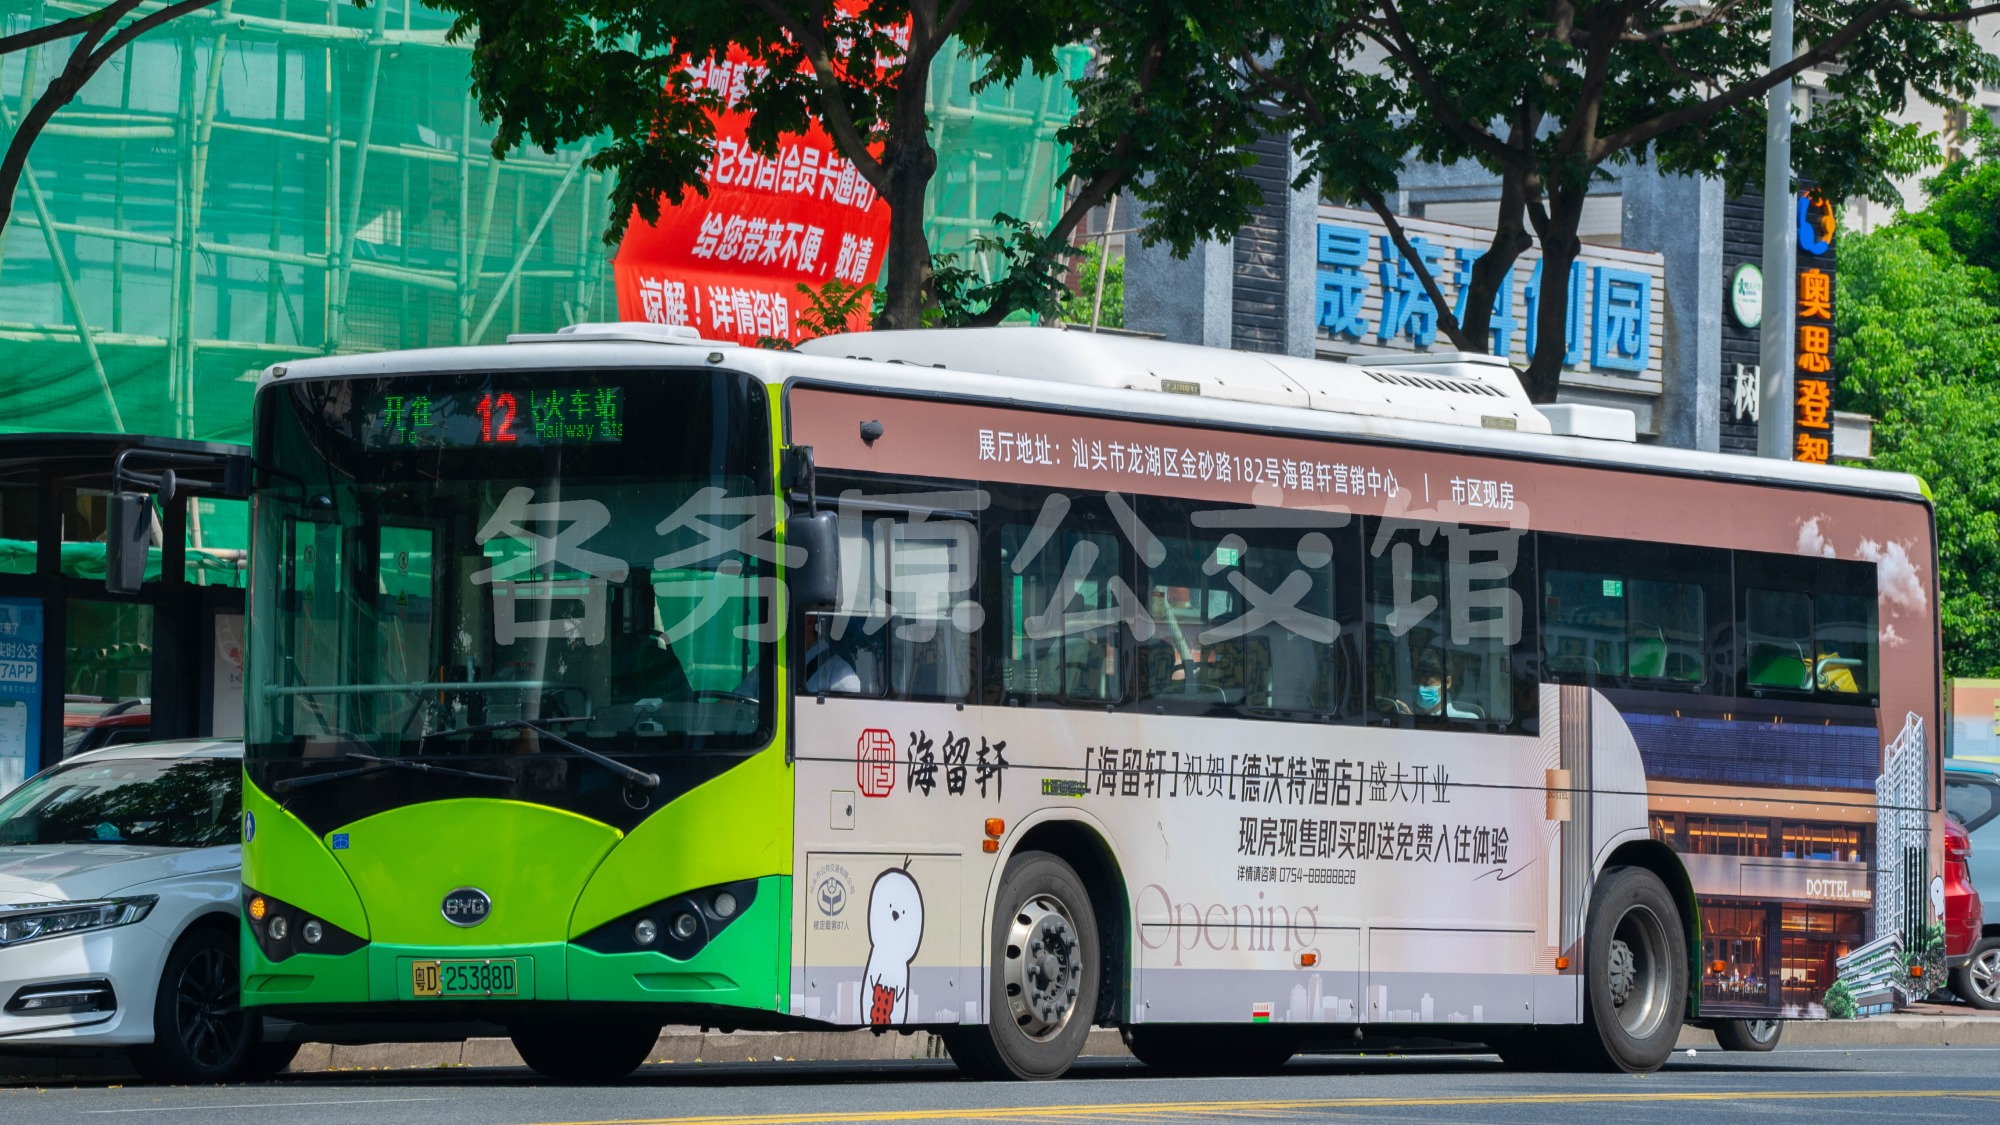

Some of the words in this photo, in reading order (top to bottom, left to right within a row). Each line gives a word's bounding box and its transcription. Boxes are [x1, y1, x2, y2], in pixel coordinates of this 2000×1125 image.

[383, 396, 433, 427] 开往
[477, 393, 516, 442] 12
[398, 427, 417, 443] To
[535, 422, 595, 440] Railway
[1450, 475, 1515, 511] 市区现房
[1237, 816, 1510, 865] 现房现售即买即送免费入住体验
[1237, 865, 1277, 883] 详情请咨询
[1279, 867, 1356, 885] 0754-88888828
[1806, 878, 1850, 898] DOTTEL
[446, 899, 485, 915] BYD
[1134, 883, 1322, 971] Opening
